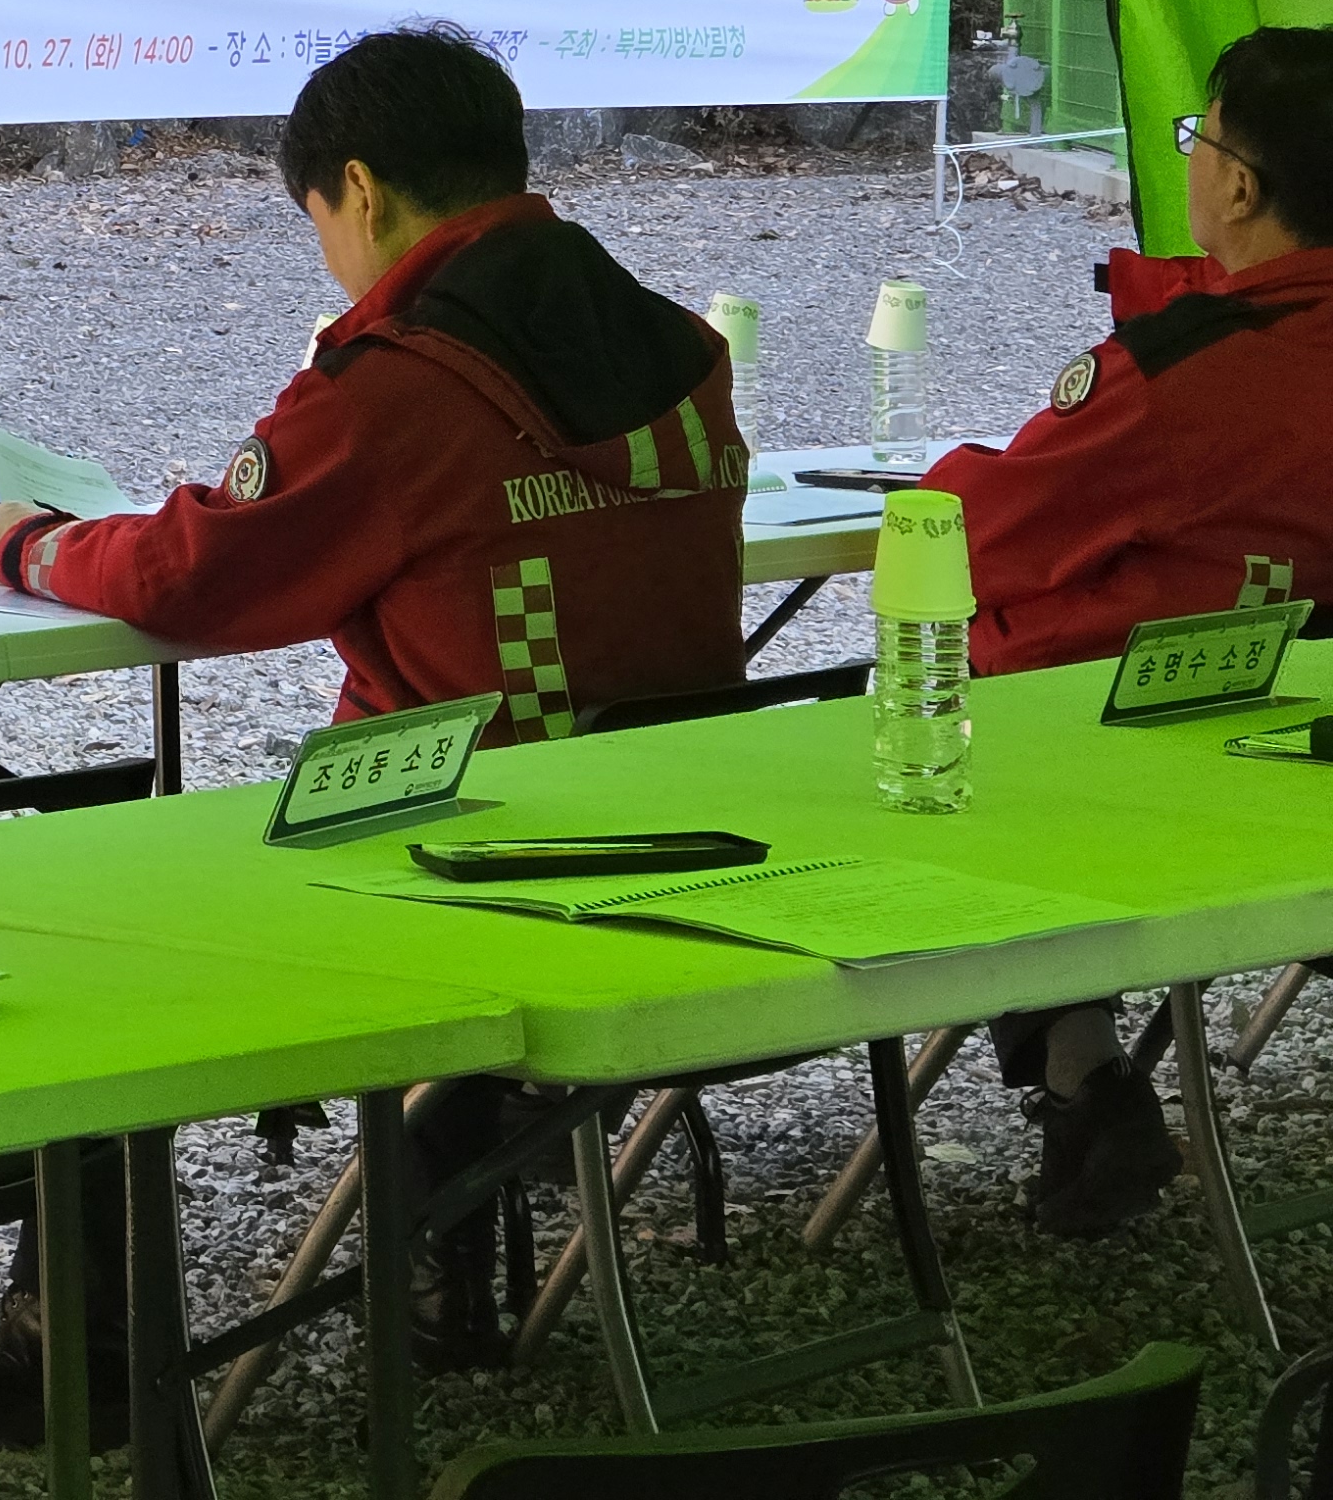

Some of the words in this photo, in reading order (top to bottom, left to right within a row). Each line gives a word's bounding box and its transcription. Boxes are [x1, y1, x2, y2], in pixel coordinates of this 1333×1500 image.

[41, 37, 74, 68] 27.
[85, 32, 123, 71] (화)
[132, 33, 194, 66] 14:00
[614, 24, 747, 60] 북부지방산림청
[502, 468, 596, 524] KOREA
[1136, 647, 1207, 687] 송명수
[1217, 637, 1267, 671] 소장
[309, 748, 391, 794] 조성동
[400, 734, 454, 773] 소장
